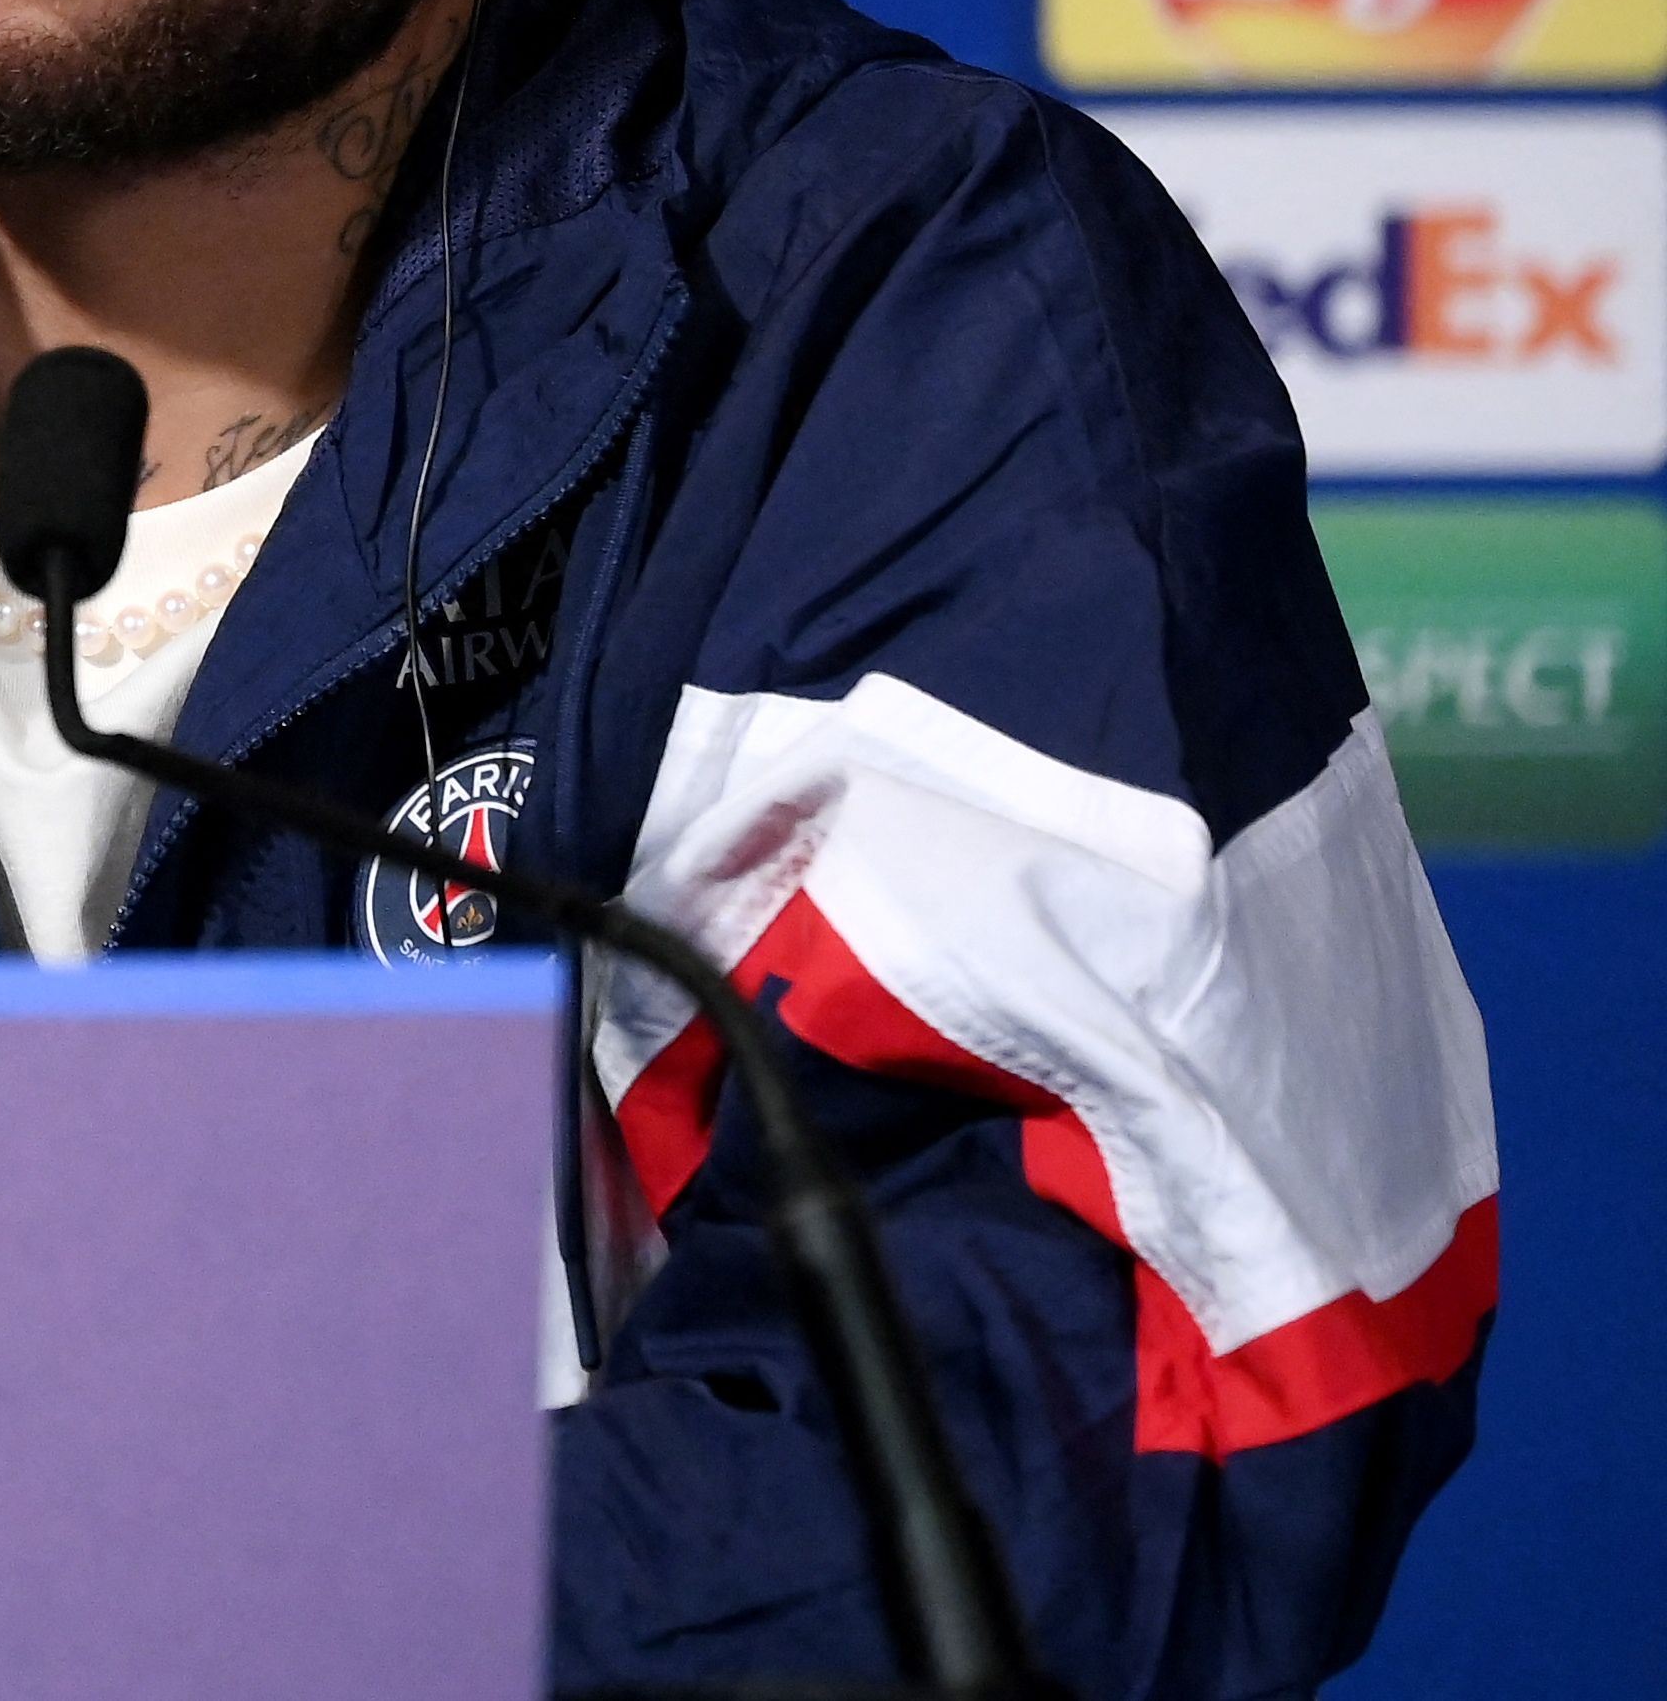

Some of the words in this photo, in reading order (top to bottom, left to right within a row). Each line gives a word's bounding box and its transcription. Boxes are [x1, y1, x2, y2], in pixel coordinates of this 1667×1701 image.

[1215, 199, 1625, 367] edEx
[395, 620, 554, 689] AIRW
[1357, 625, 1625, 727] SPECT
